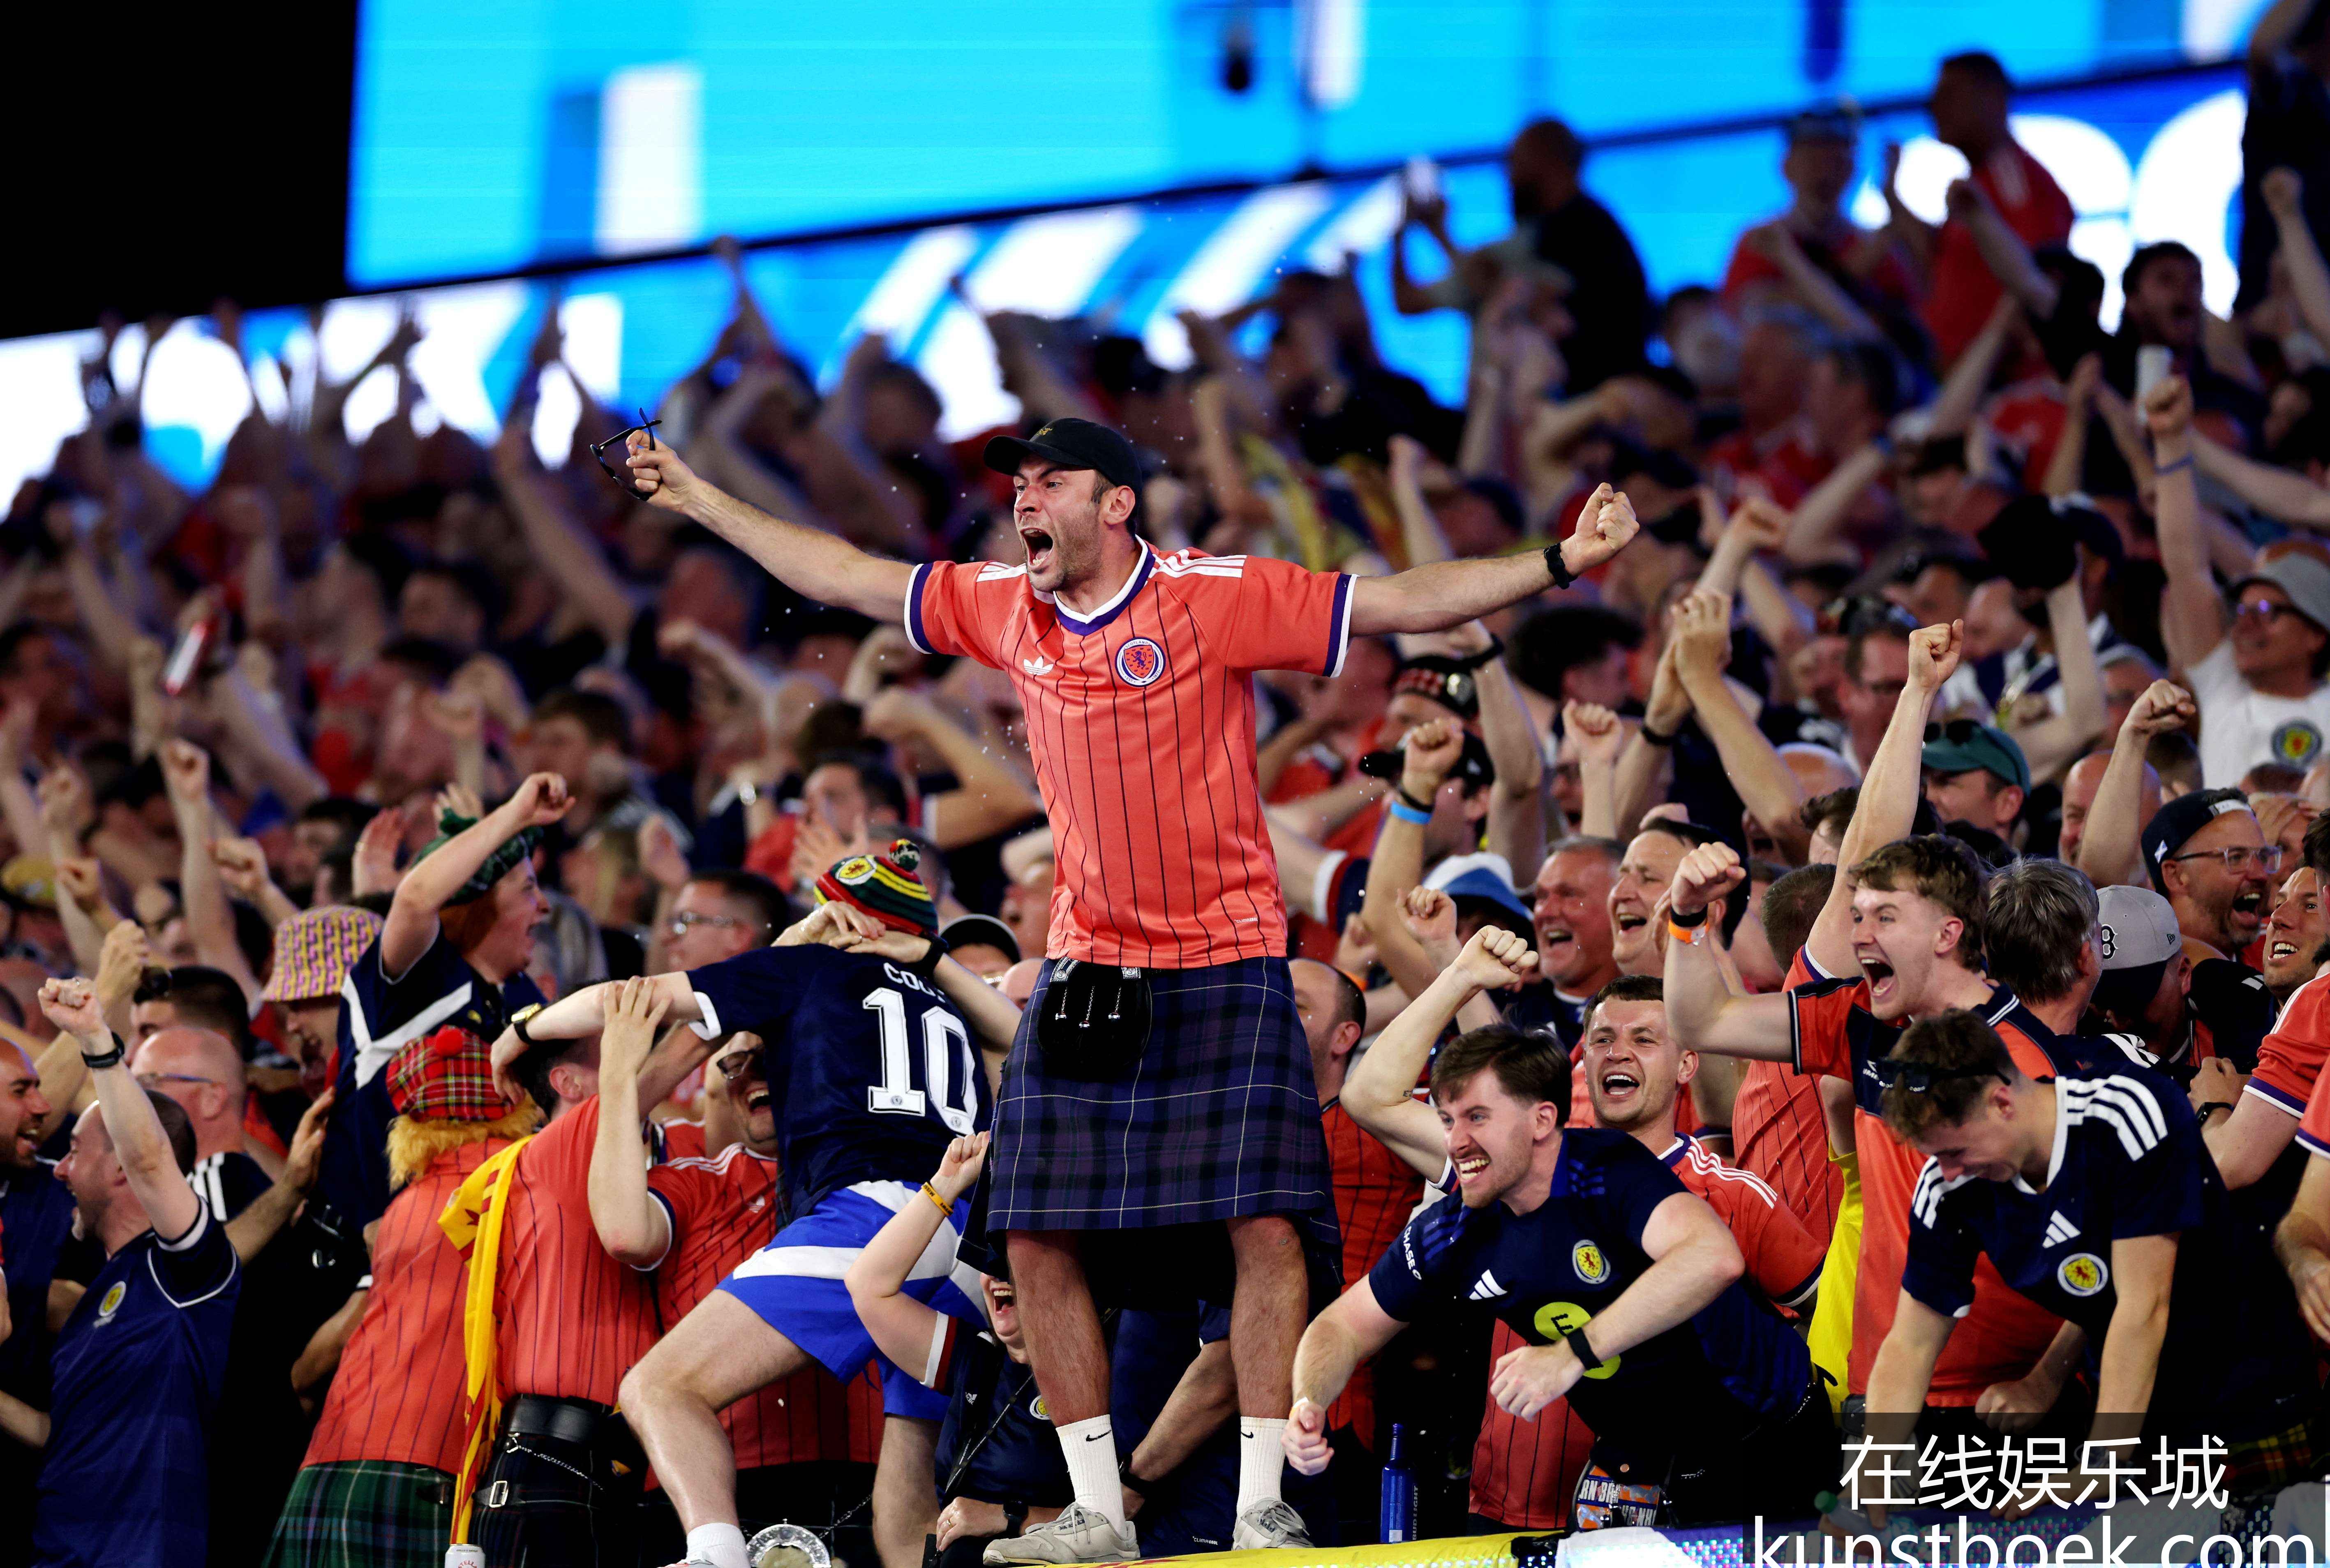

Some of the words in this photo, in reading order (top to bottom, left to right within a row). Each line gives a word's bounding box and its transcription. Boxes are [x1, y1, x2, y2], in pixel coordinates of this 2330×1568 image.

[2101, 924, 2118, 960] B
[863, 987, 978, 1138] 10
[1403, 1226, 1416, 1270] CHASE
